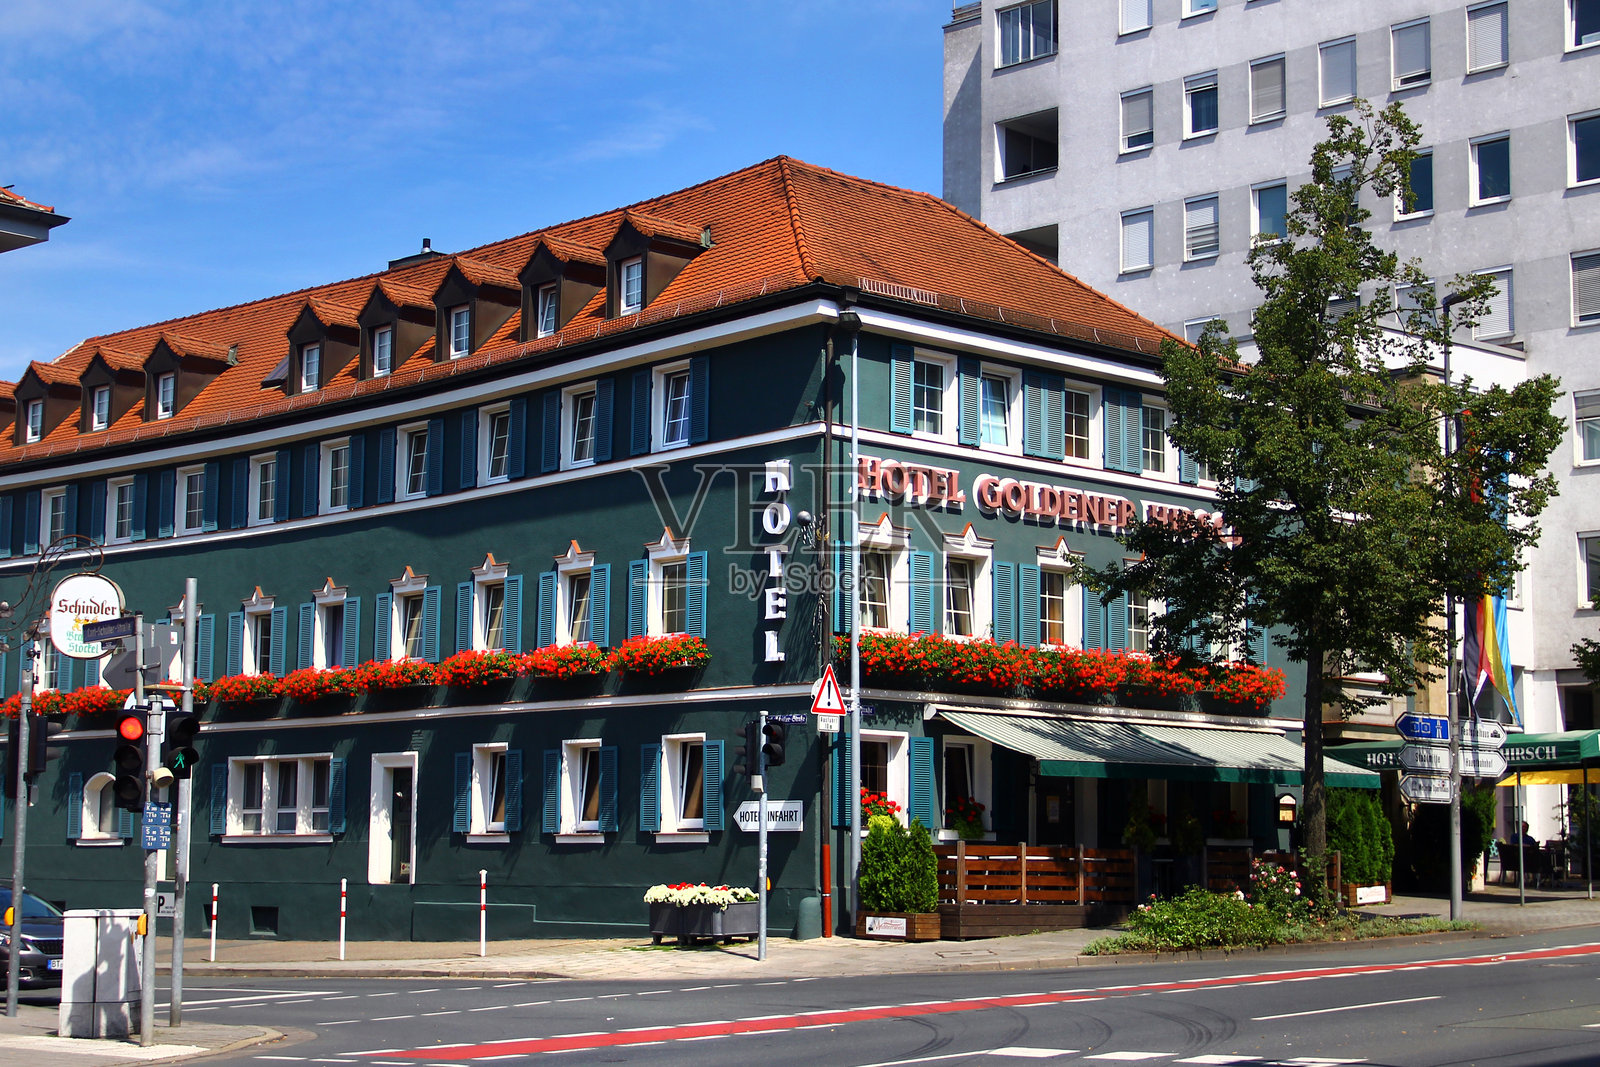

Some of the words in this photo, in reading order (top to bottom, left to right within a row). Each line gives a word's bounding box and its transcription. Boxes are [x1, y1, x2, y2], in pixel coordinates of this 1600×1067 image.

[850, 453, 966, 509] HOTEL
[974, 474, 1136, 531] GOLDENER
[763, 459, 791, 662] HOTEL
[57, 597, 117, 616] Schindler
[67, 642, 99, 654] Stöckel
[1367, 752, 1400, 766] HOT
[1500, 745, 1557, 761] HIRSCH
[739, 810, 799, 822] HOTEINFAHRT
[157, 895, 165, 913] P
